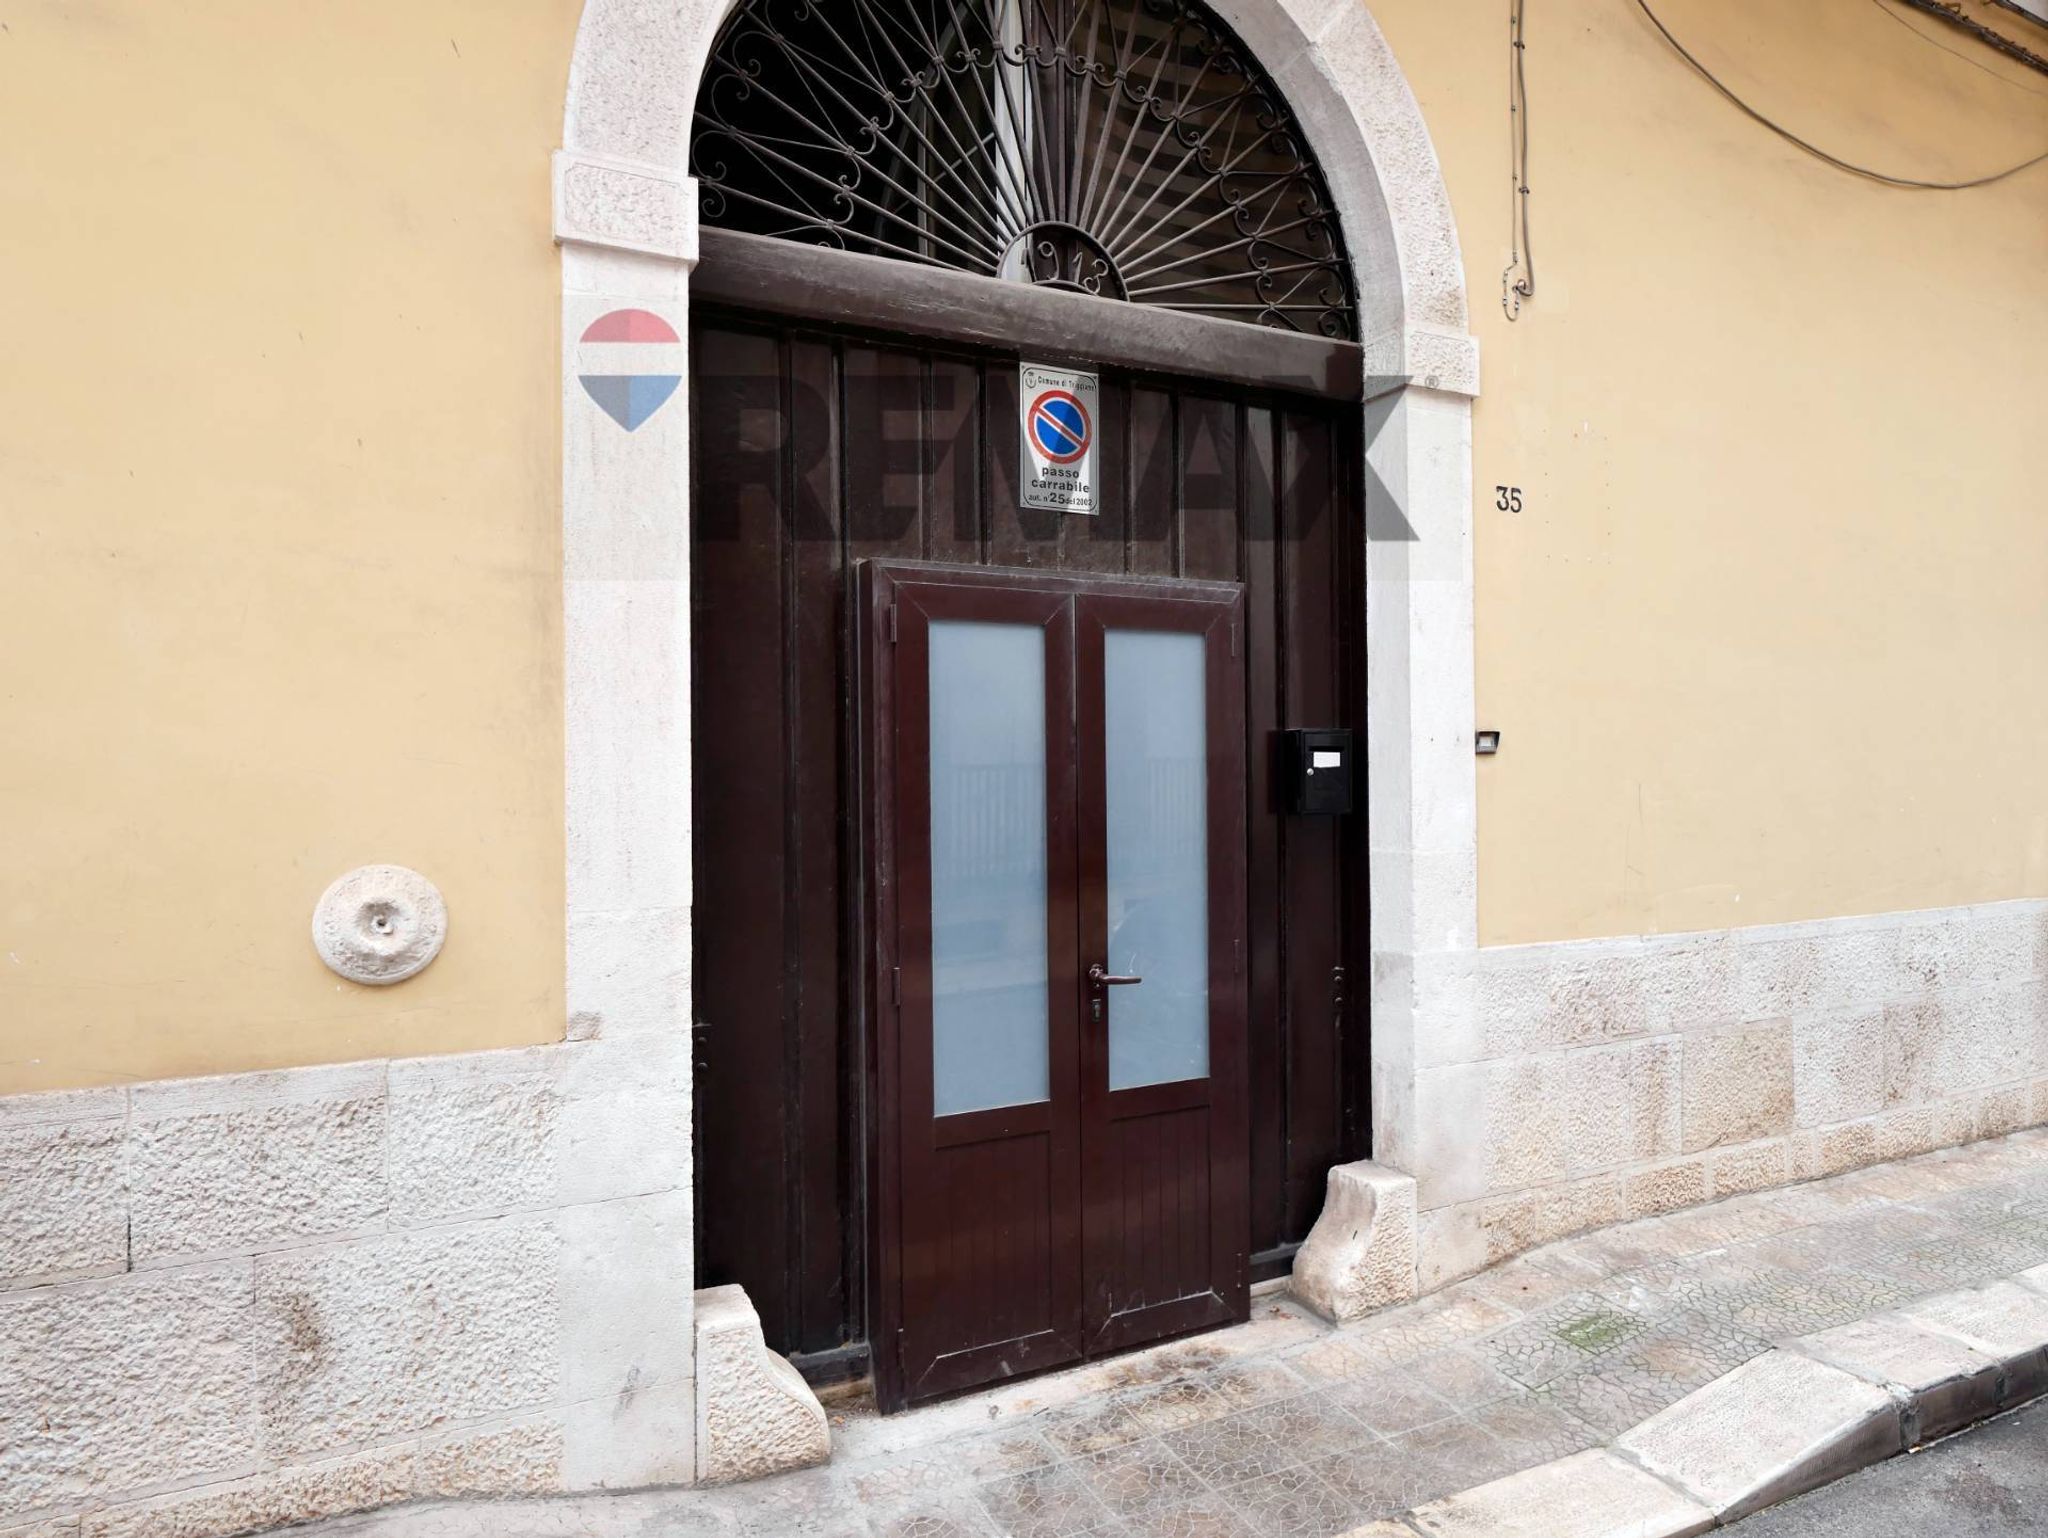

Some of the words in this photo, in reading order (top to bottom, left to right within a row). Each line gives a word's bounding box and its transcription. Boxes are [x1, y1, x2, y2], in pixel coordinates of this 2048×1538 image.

[1037, 375, 1060, 386] Comune
[1042, 467, 1080, 478] passo
[1031, 479, 1090, 492] carrabile
[1496, 485, 1522, 513] 35
